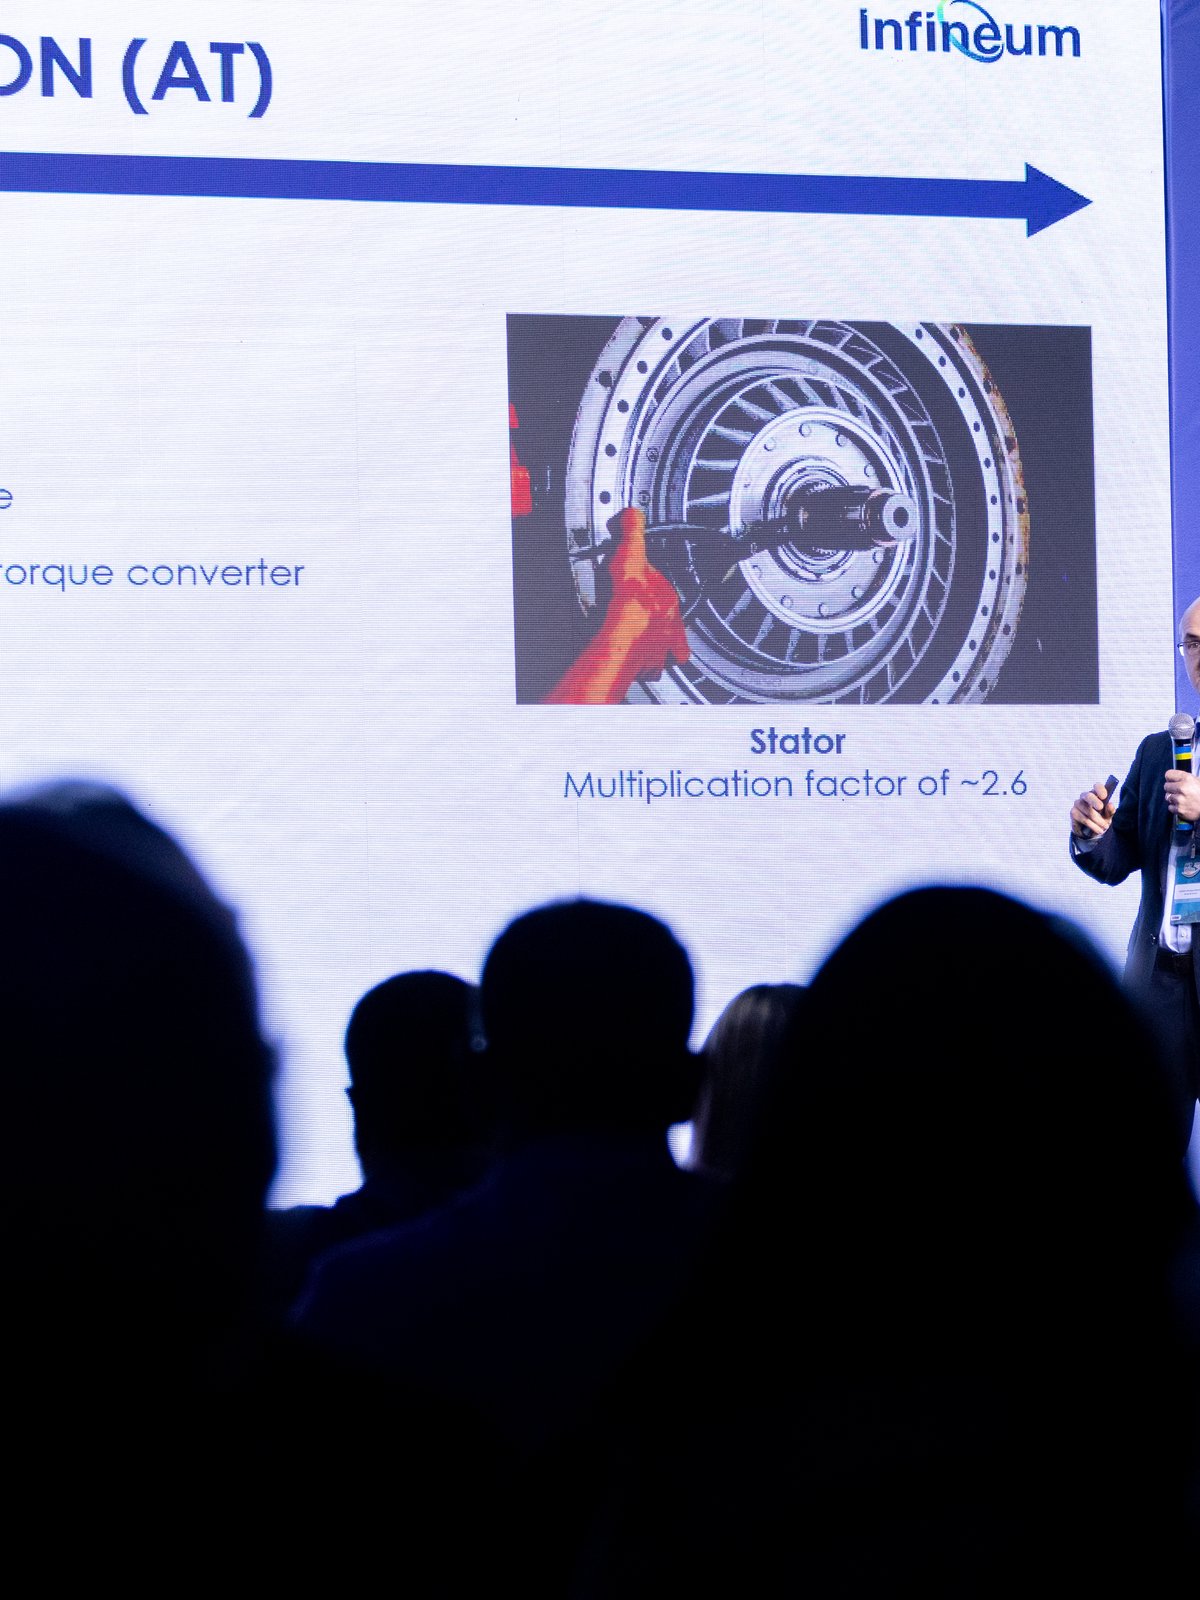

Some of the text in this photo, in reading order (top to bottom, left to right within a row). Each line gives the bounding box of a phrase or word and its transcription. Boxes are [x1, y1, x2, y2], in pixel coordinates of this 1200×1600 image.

[859, 8, 1081, 62] Infineum
[122, 37, 273, 118] (AT)
[0, 558, 305, 592] orque converter
[750, 727, 846, 755] Stator
[563, 768, 1028, 804] Multiplication factor of ~2.6
